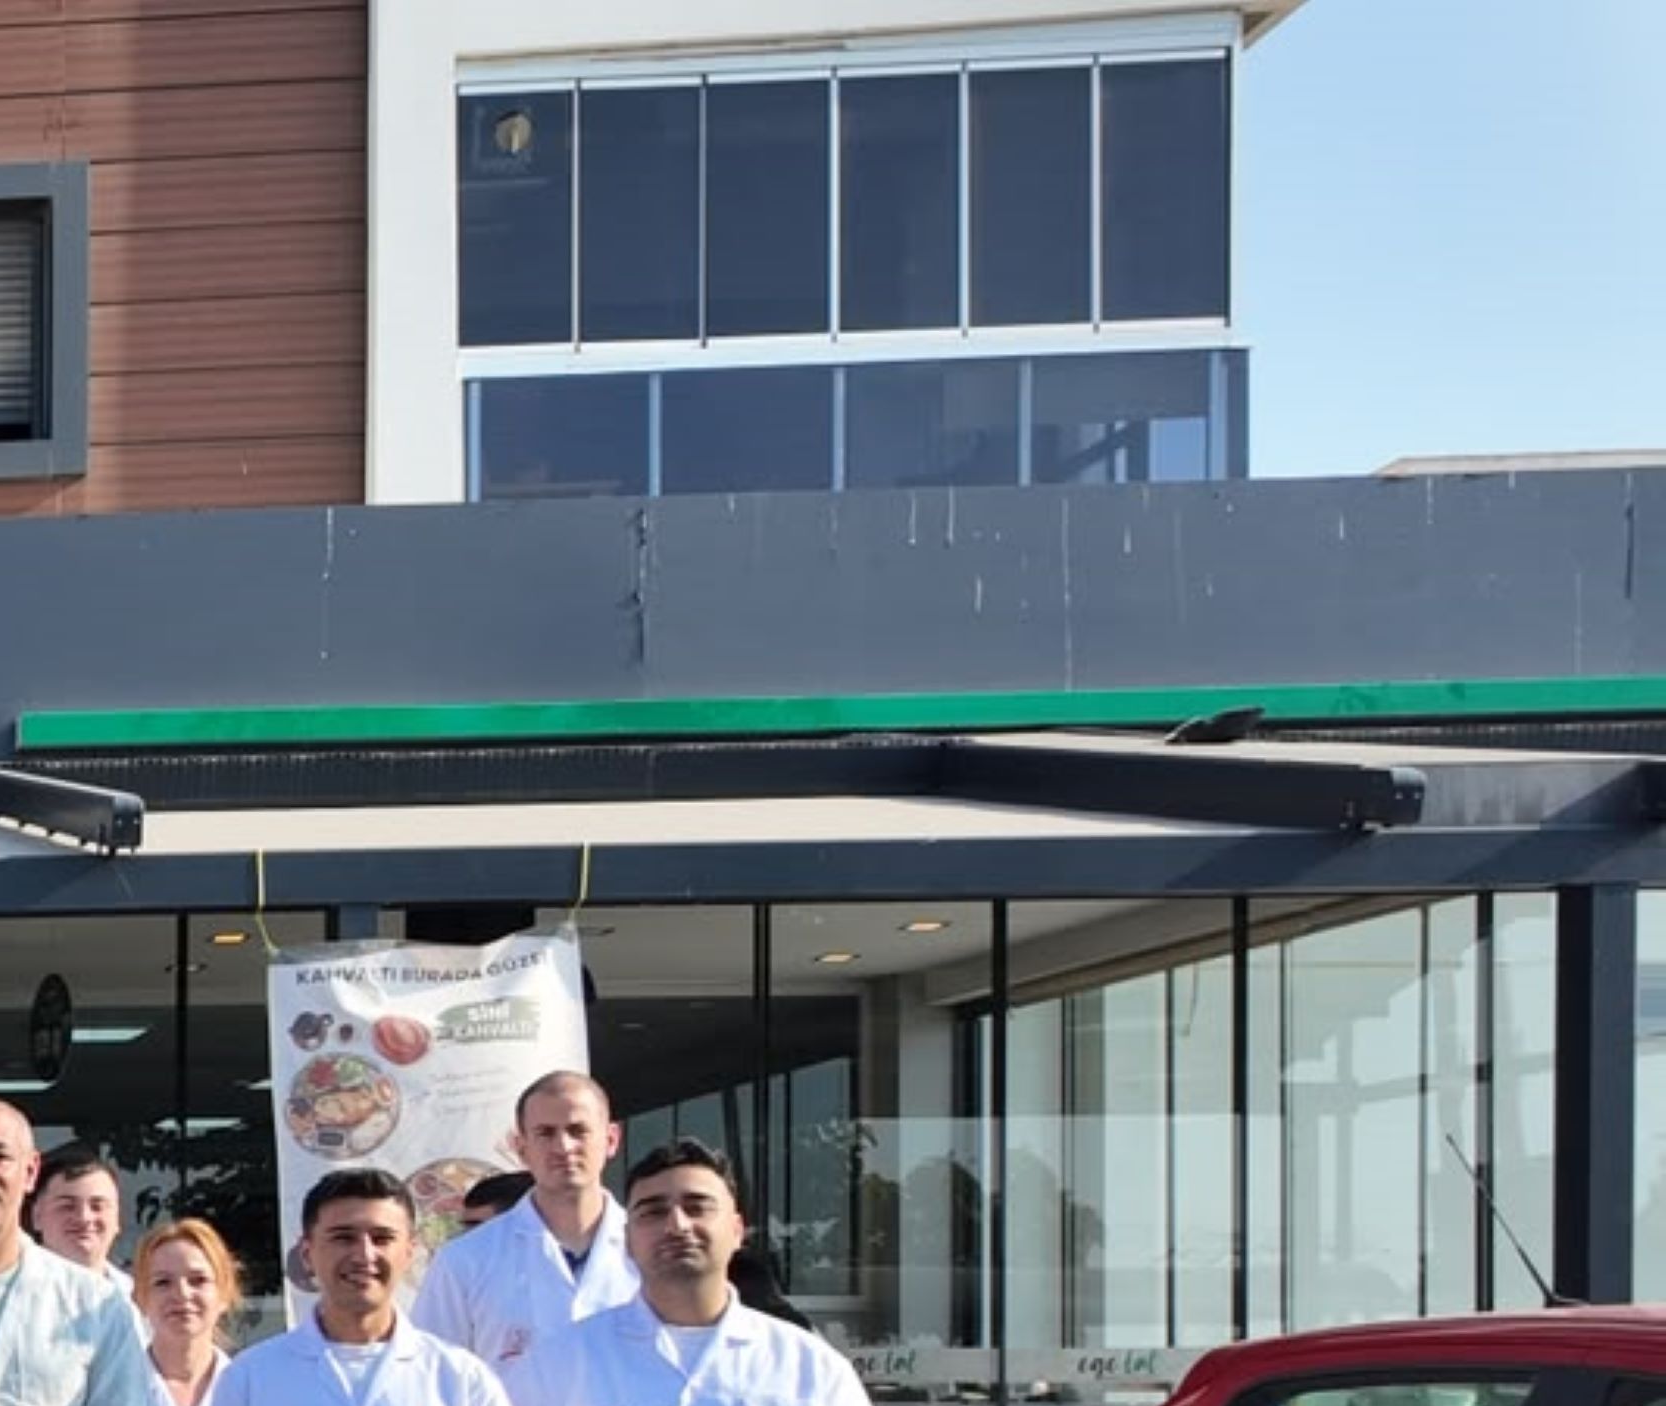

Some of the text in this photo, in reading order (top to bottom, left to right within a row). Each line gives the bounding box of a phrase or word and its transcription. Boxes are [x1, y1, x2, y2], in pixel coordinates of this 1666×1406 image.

[295, 967, 397, 986] KAHVTI
[487, 951, 540, 977] GÜZE
[853, 1353, 875, 1377] ge
